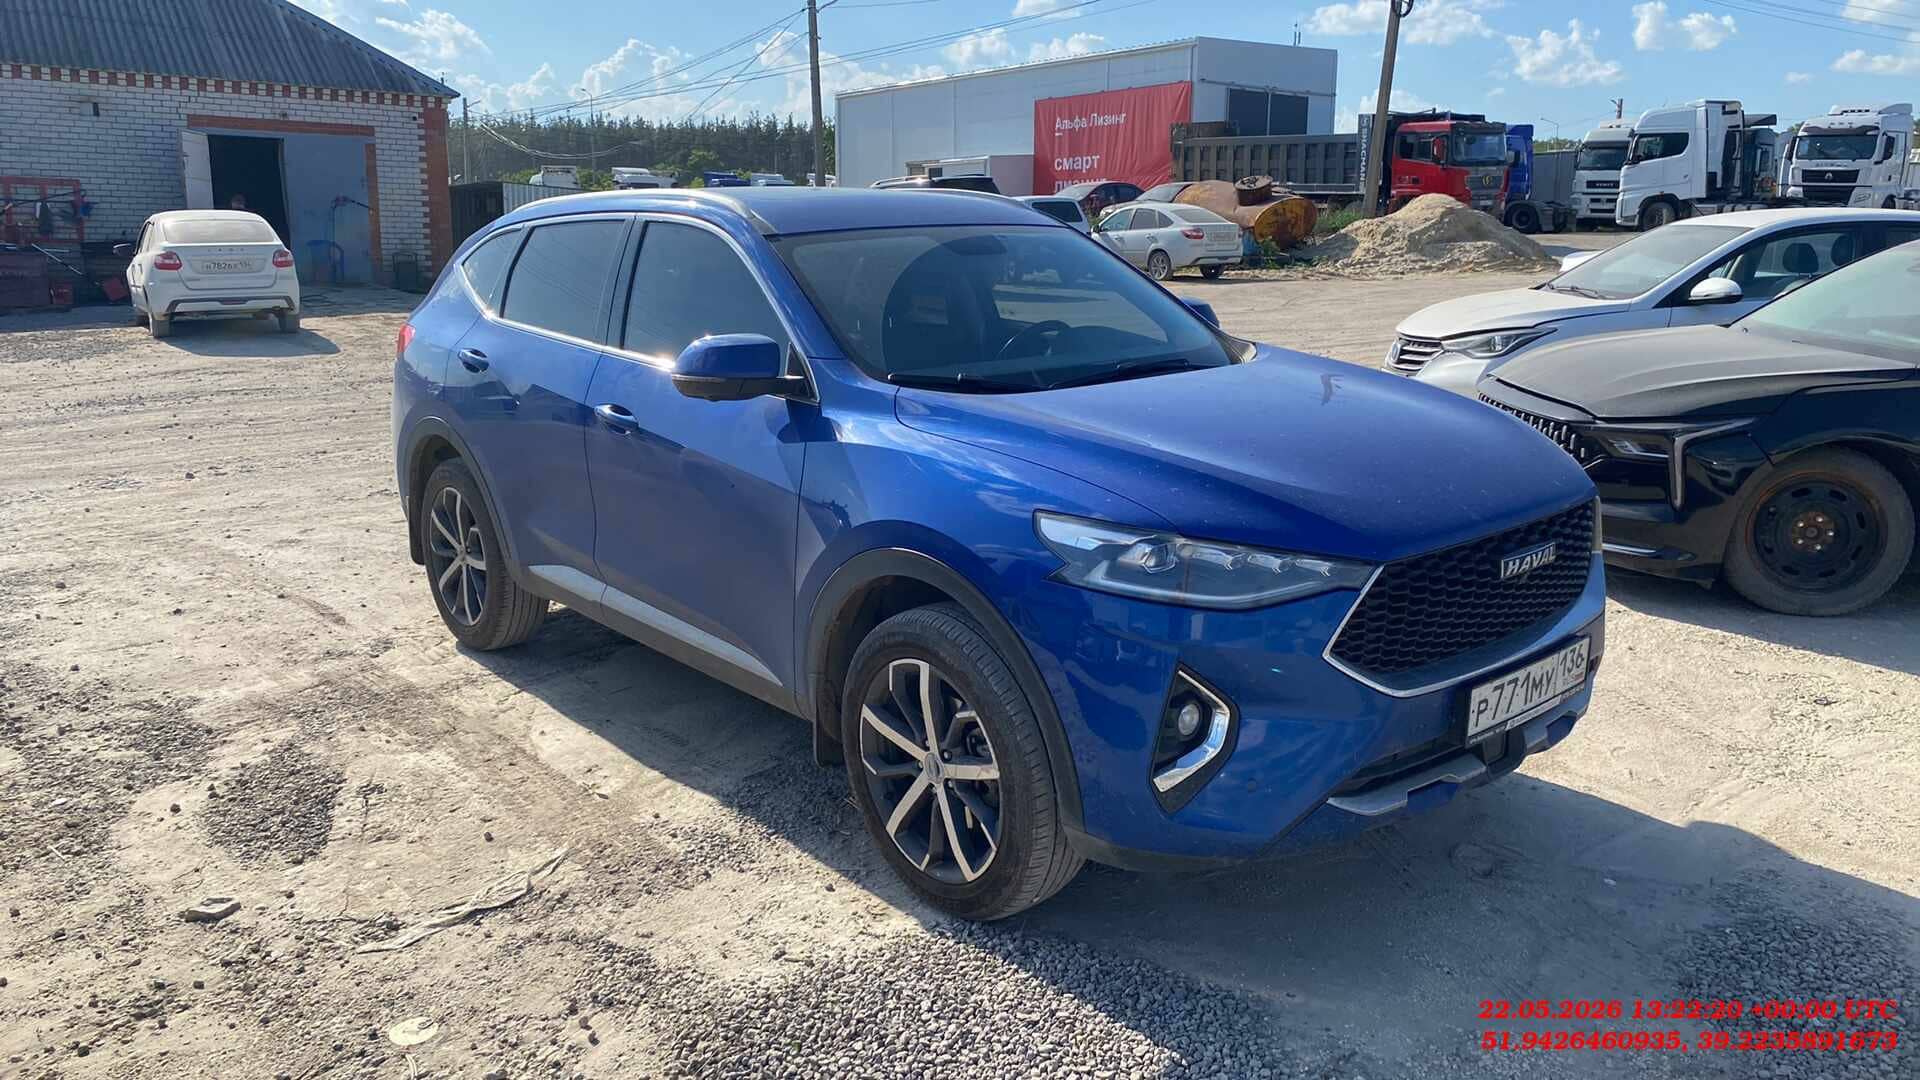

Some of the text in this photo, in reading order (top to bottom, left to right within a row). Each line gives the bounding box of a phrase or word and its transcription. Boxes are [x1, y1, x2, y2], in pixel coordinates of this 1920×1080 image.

[1055, 113, 1126, 131] Альфа Лизинг
[1055, 155, 1100, 173] смарт
[1360, 128, 1368, 181] SHACMAN
[1505, 546, 1556, 577] HAVAL
[1560, 643, 1584, 676] 136
